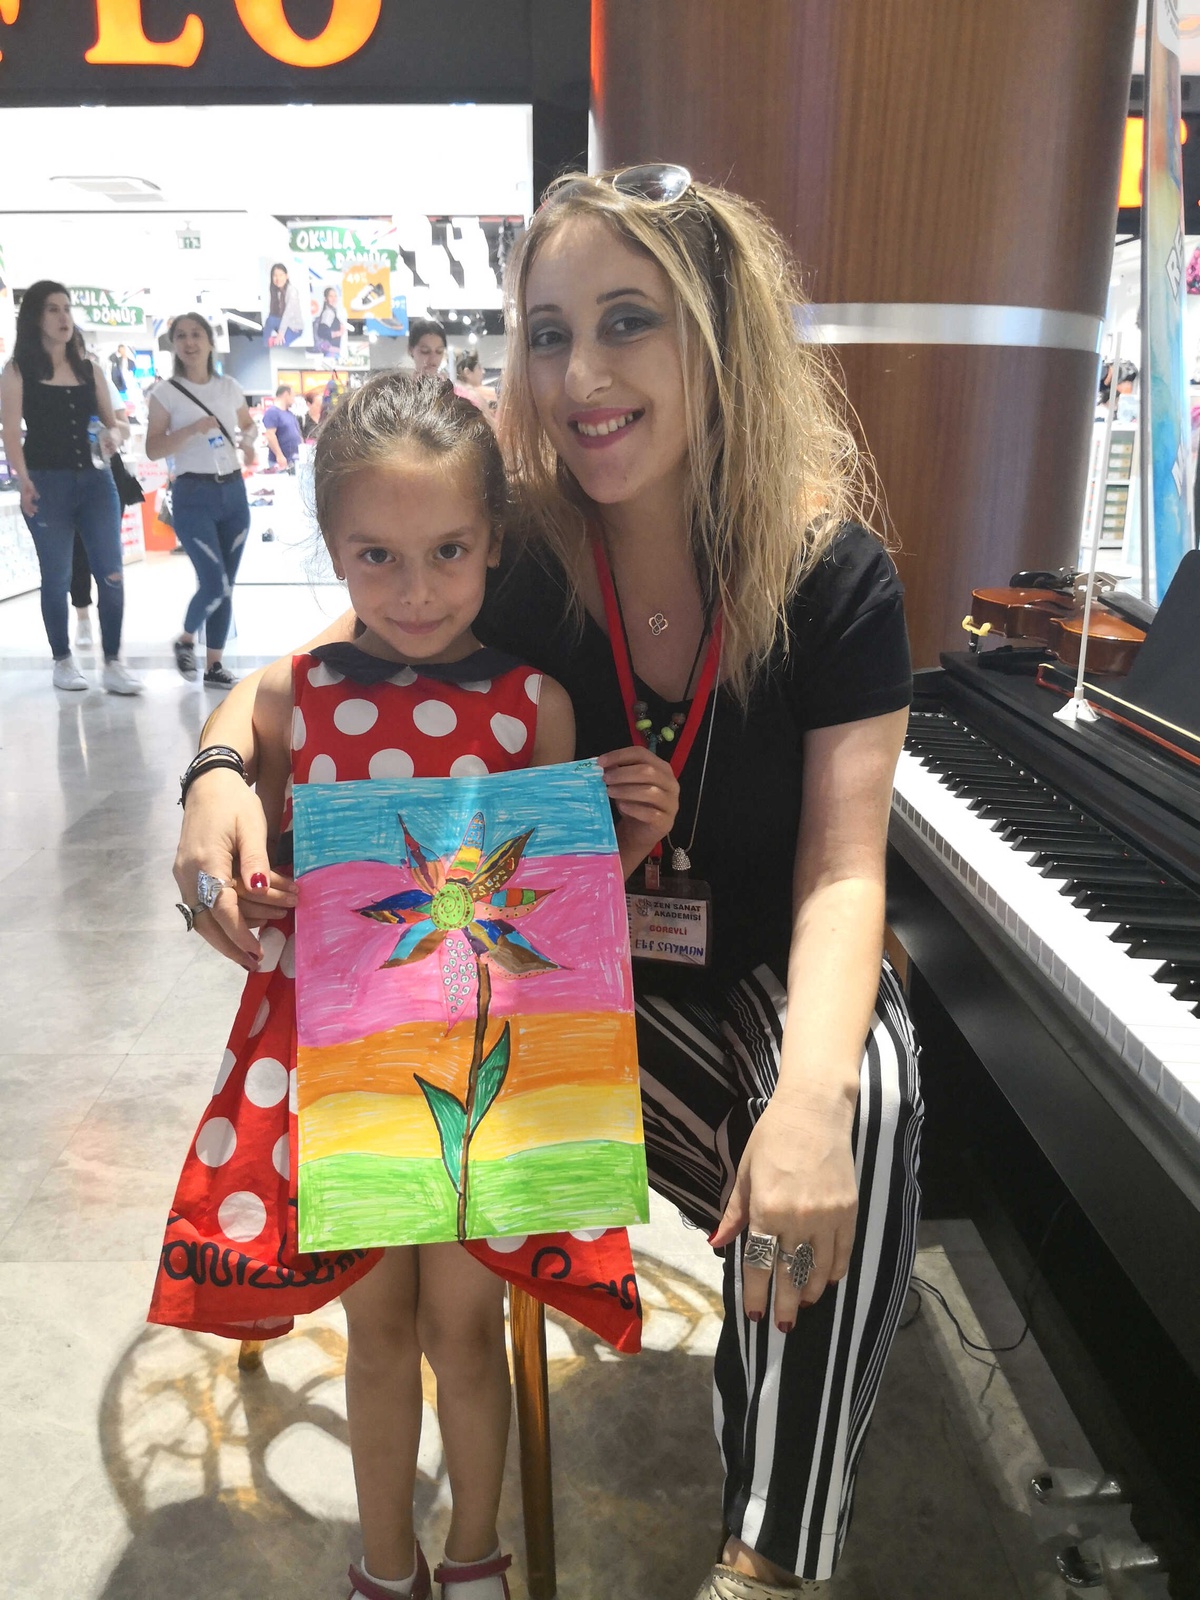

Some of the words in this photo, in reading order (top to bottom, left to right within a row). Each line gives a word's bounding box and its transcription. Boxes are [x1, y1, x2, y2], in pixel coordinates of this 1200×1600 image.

[0, 0, 382, 68] LO
[296, 228, 357, 250] OKULA
[70, 289, 111, 306] KULA
